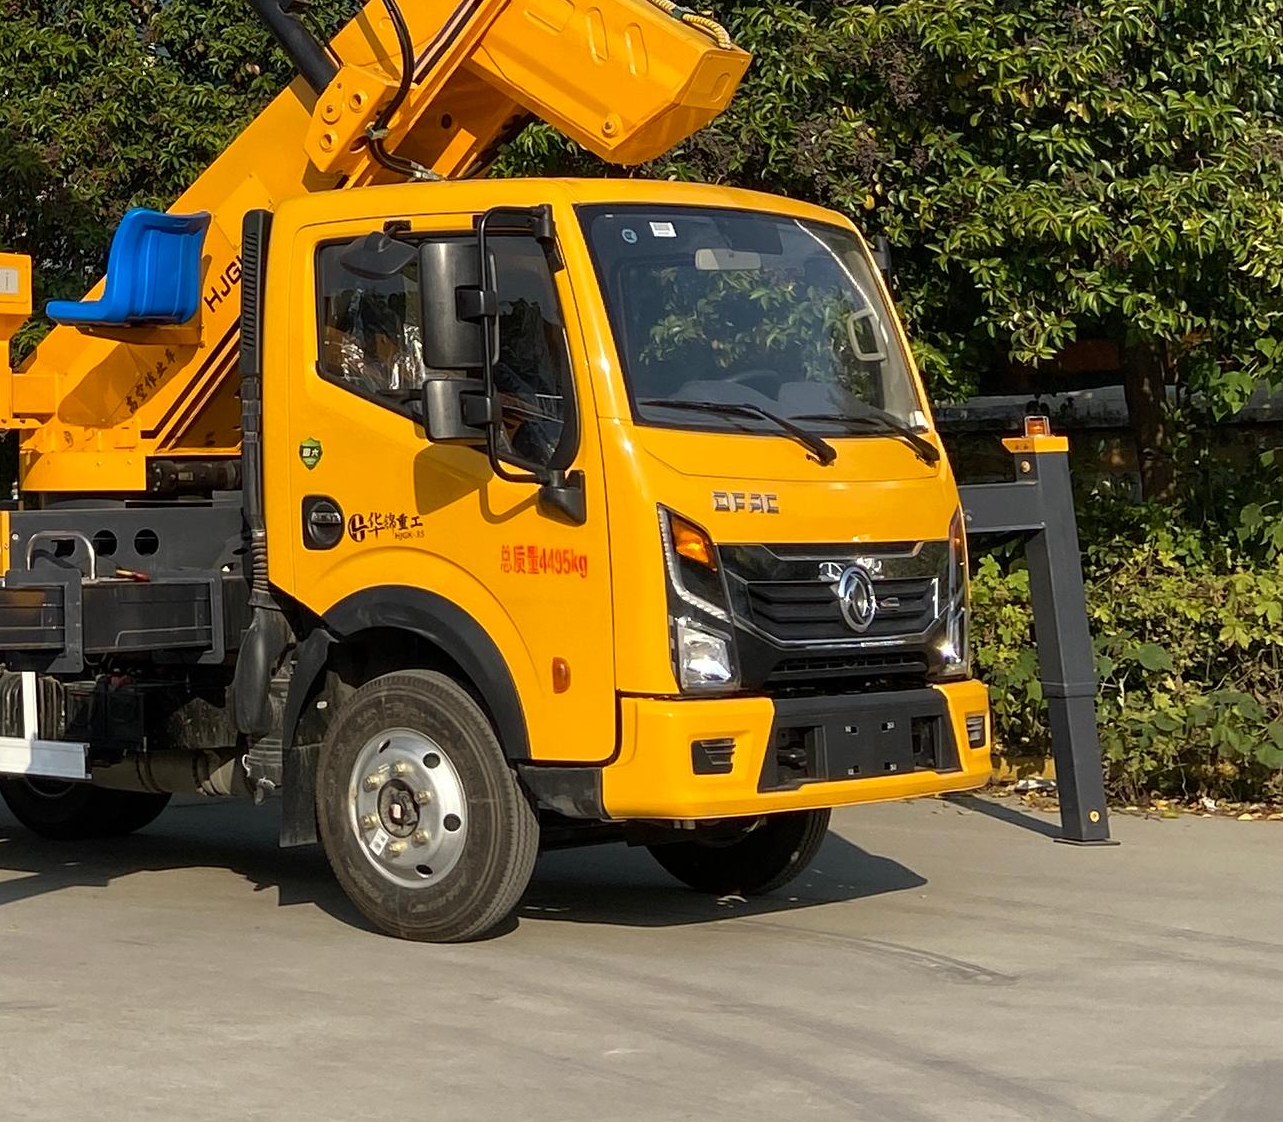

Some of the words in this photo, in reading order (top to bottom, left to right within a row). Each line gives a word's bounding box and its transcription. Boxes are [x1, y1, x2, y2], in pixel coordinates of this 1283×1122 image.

[204, 255, 243, 313] HJG
[712, 491, 780, 514] DFAC
[368, 512, 424, 539] 华锦重工
